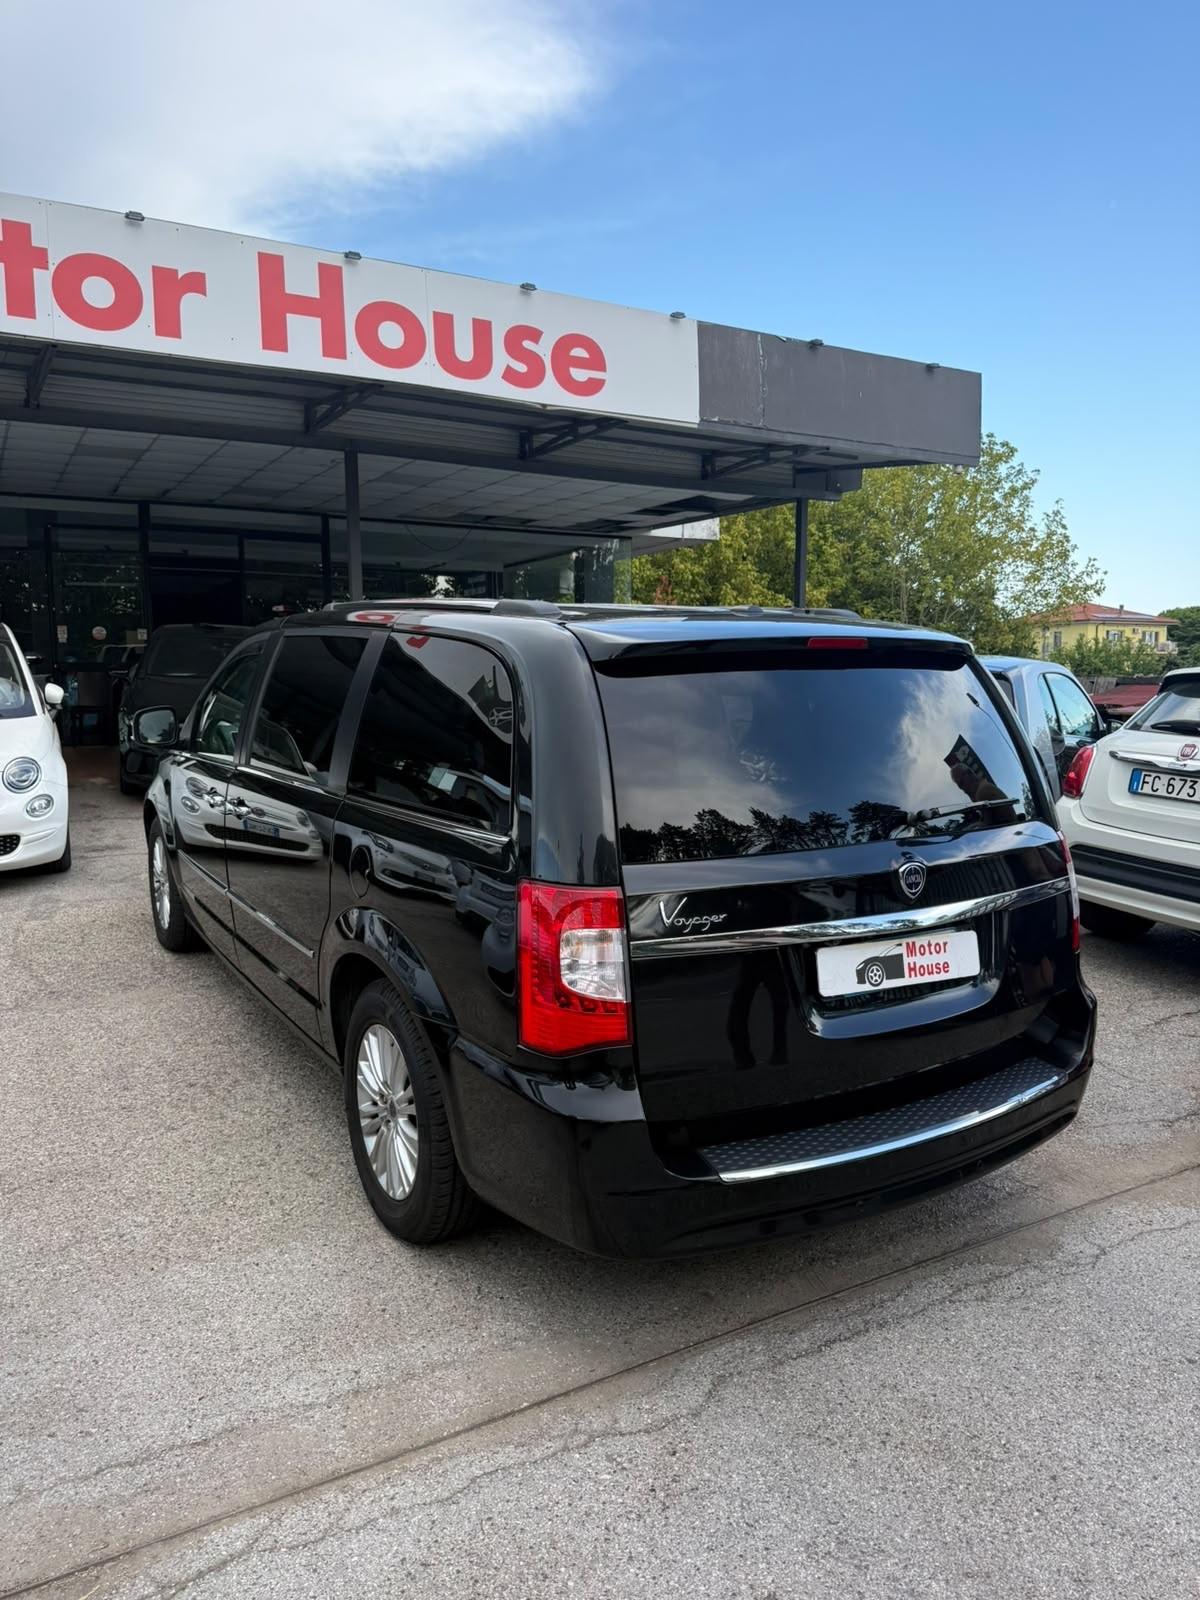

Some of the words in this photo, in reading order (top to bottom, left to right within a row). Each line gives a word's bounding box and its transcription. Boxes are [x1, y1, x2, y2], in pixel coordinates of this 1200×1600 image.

[257, 251, 608, 398] House
[1140, 773, 1161, 793] FC
[1166, 778, 1199, 798] 673
[659, 897, 728, 933] Voyager
[906, 940, 949, 958] Motor
[907, 961, 950, 978] House
